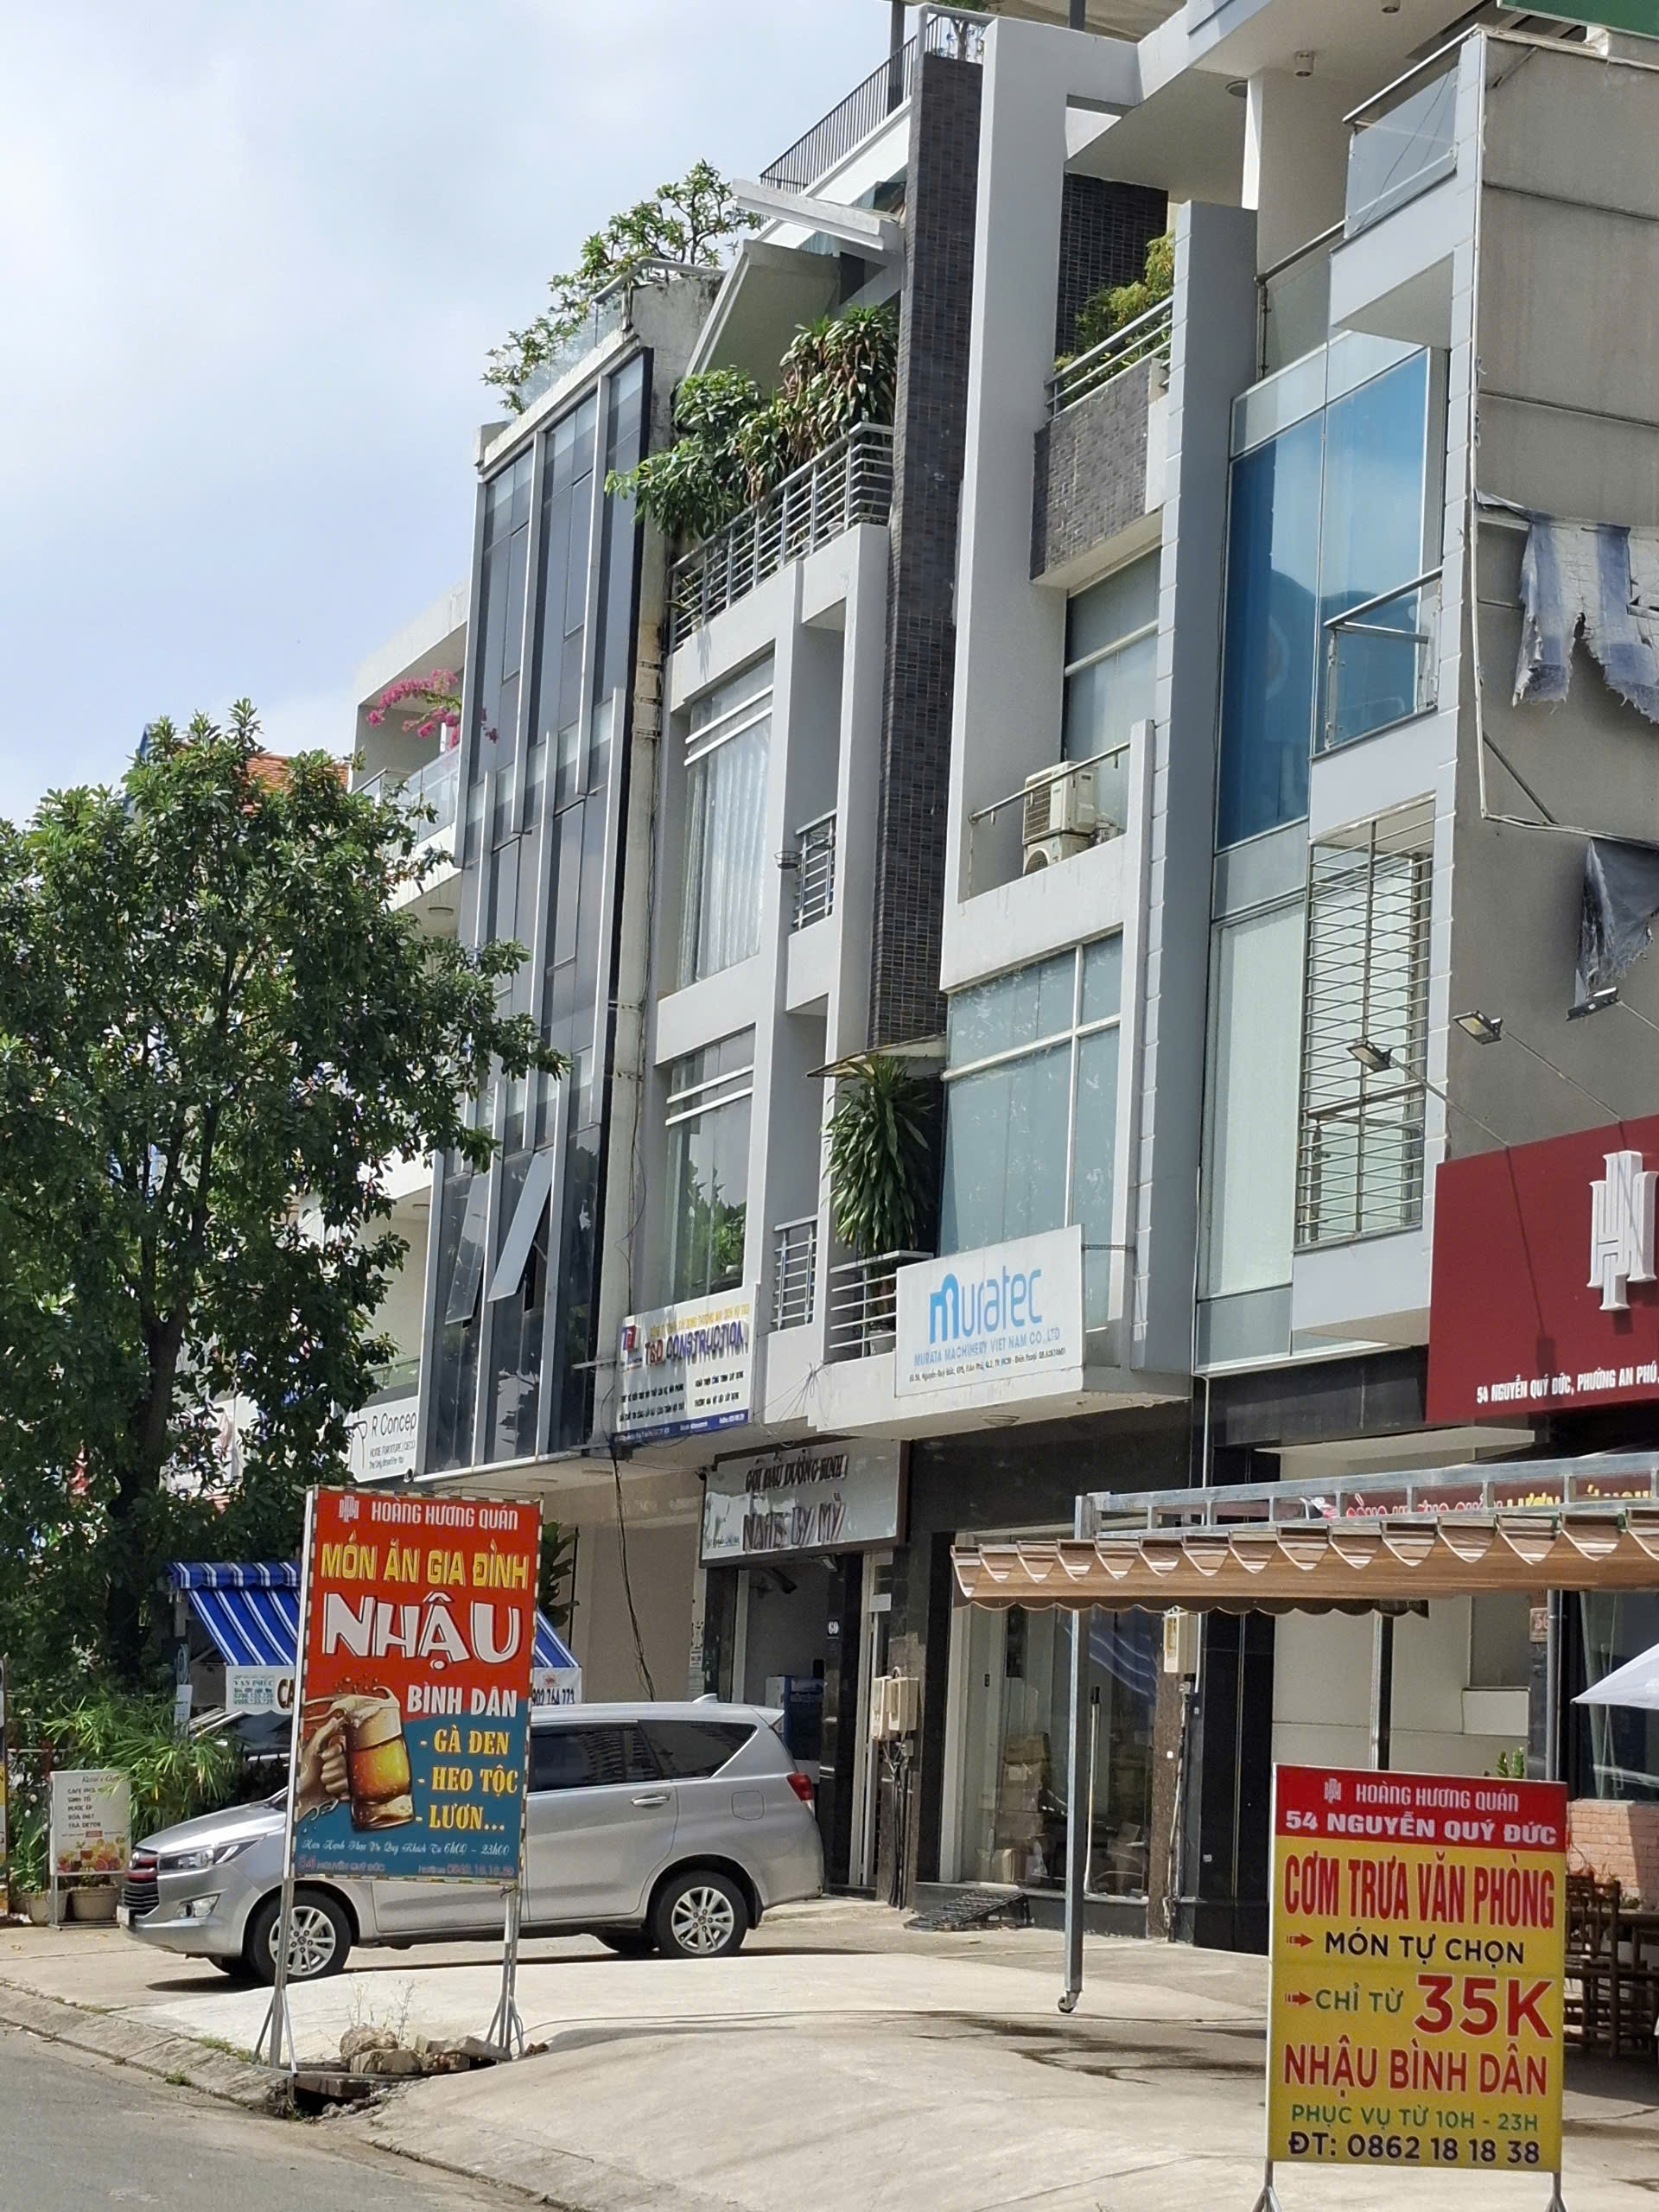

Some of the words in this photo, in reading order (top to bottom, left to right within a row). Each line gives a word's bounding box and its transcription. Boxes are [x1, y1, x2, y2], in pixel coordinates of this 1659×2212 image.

[913, 1350, 942, 1367] MURATA
[944, 1340, 988, 1361] MACHINERY
[991, 1338, 1006, 1351] VIET
[1009, 1333, 1027, 1348] NAM
[1491, 1374, 1527, 1402] NGUYỄN
[1530, 1374, 1548, 1399] QUÝ
[1551, 1372, 1573, 1395] ĐỨC,
[1618, 1367, 1633, 1387] AN
[372, 1498, 421, 1524] HOÀNG
[424, 1503, 474, 1527] HƯƠNG
[479, 1505, 518, 1529] QUÁN
[321, 1529, 377, 1580] MÓN
[384, 1538, 419, 1583] ĂN
[428, 1549, 466, 1586] GIA
[473, 1538, 529, 1590] ĐÌNH
[321, 1592, 520, 1670] NHẬU
[829, 1621, 839, 1634] 60
[407, 1681, 461, 1715] BÌNH
[471, 1684, 518, 1718] DÂN
[434, 1725, 461, 1755] GÀ
[468, 1730, 510, 1756] ĐEN
[432, 1767, 473, 1792] HEO
[480, 1764, 518, 1796] TỘC
[1356, 1780, 1411, 1805] HOÀNG
[1415, 1787, 1470, 1809] HƯƠNG
[1475, 1789, 1519, 1812] QUÁN
[1286, 1810, 1318, 1831] 54
[1327, 1811, 1434, 1838] NGUYỄN
[1445, 1819, 1496, 1842] QUÝ
[1503, 1822, 1556, 1845] ĐỨC
[1284, 1850, 1340, 1916] CƠM
[1348, 1855, 1409, 1920] TRƯA
[1417, 1851, 1466, 1923] VĂN
[1473, 1853, 1554, 1929] PHÒNG
[1325, 1926, 1389, 1956] MÓN
[1399, 1933, 1436, 1965] TỰ
[1446, 1941, 1524, 1968] CHỌN
[1315, 1982, 1359, 2011] CHỈ
[1369, 1987, 1405, 2013] TỪ
[1414, 1973, 1554, 2038] 35K
[1284, 2034, 1378, 2098] NHẬU
[1389, 2037, 1467, 2092] BÌNH
[1478, 2042, 1547, 2095] DÂN
[1292, 2104, 1352, 2127] PHỤC
[1361, 2107, 1391, 2130] VỤ
[1399, 2104, 1428, 2127] TỪ
[1437, 2110, 1475, 2129] 10H
[1497, 2113, 1538, 2132] 23H
[1288, 2131, 1337, 2156] ĐT:
[1347, 2133, 1420, 2159] 0862
[1431, 2137, 1459, 2161] 18
[1470, 2139, 1496, 2162] 18
[1507, 2140, 1540, 2164] 38
